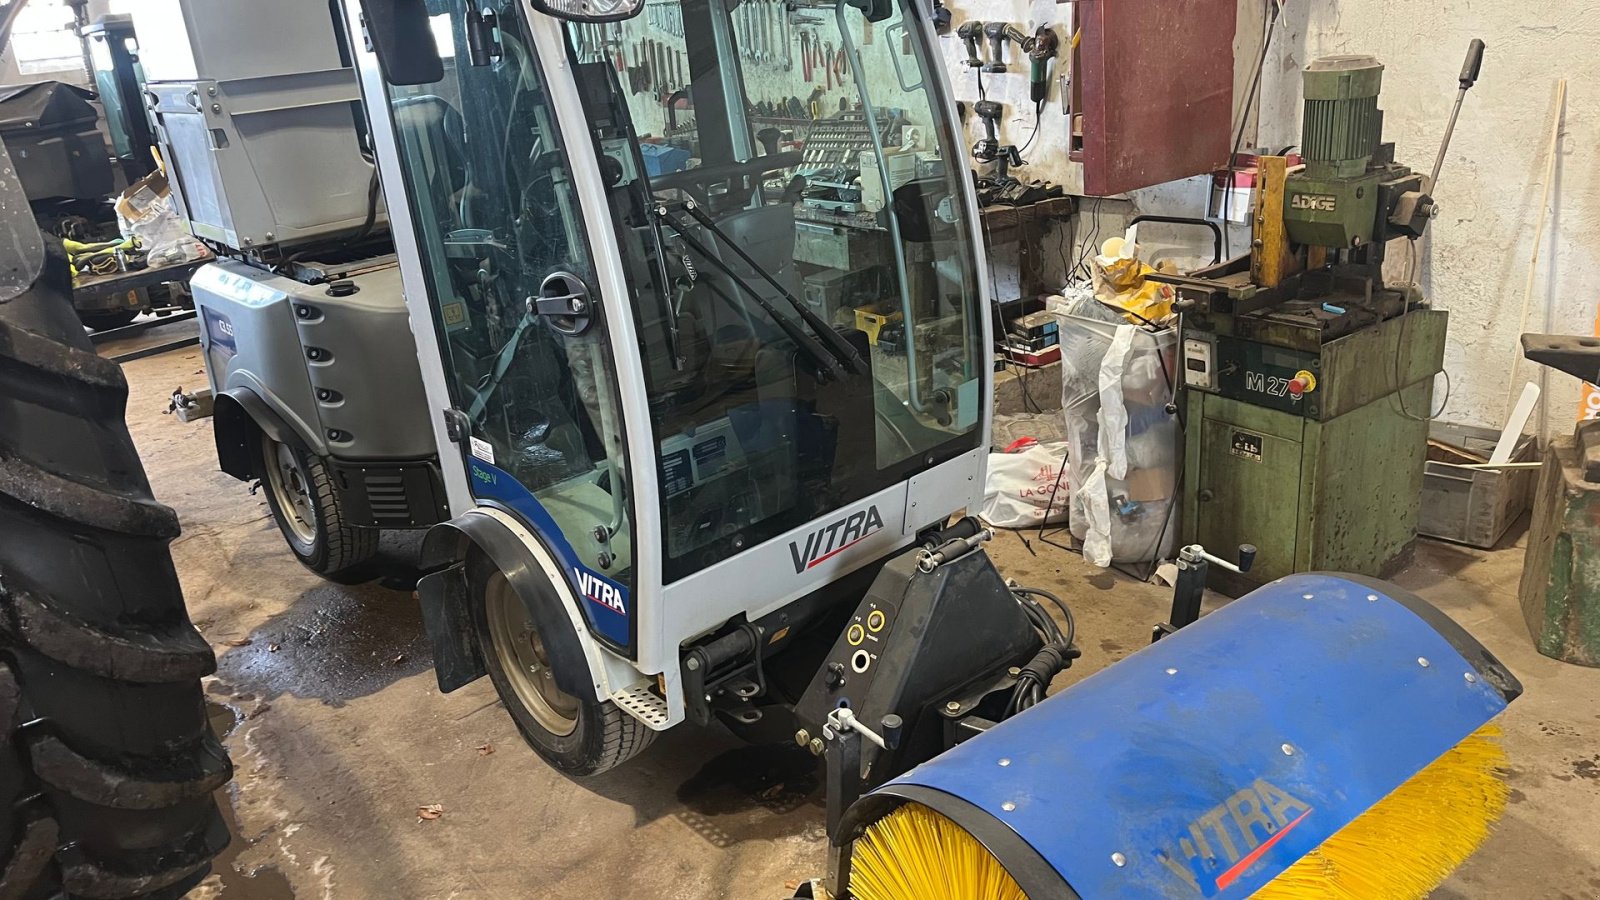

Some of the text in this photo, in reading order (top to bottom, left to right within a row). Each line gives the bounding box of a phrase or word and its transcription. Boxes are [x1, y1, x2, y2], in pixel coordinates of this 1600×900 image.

[1245, 371, 1265, 393] M
[472, 465, 497, 486] Stage V
[1019, 488, 1034, 498] LA
[789, 505, 884, 574] VITRA
[573, 566, 626, 614] VITRA
[1156, 778, 1310, 893] VITRA
